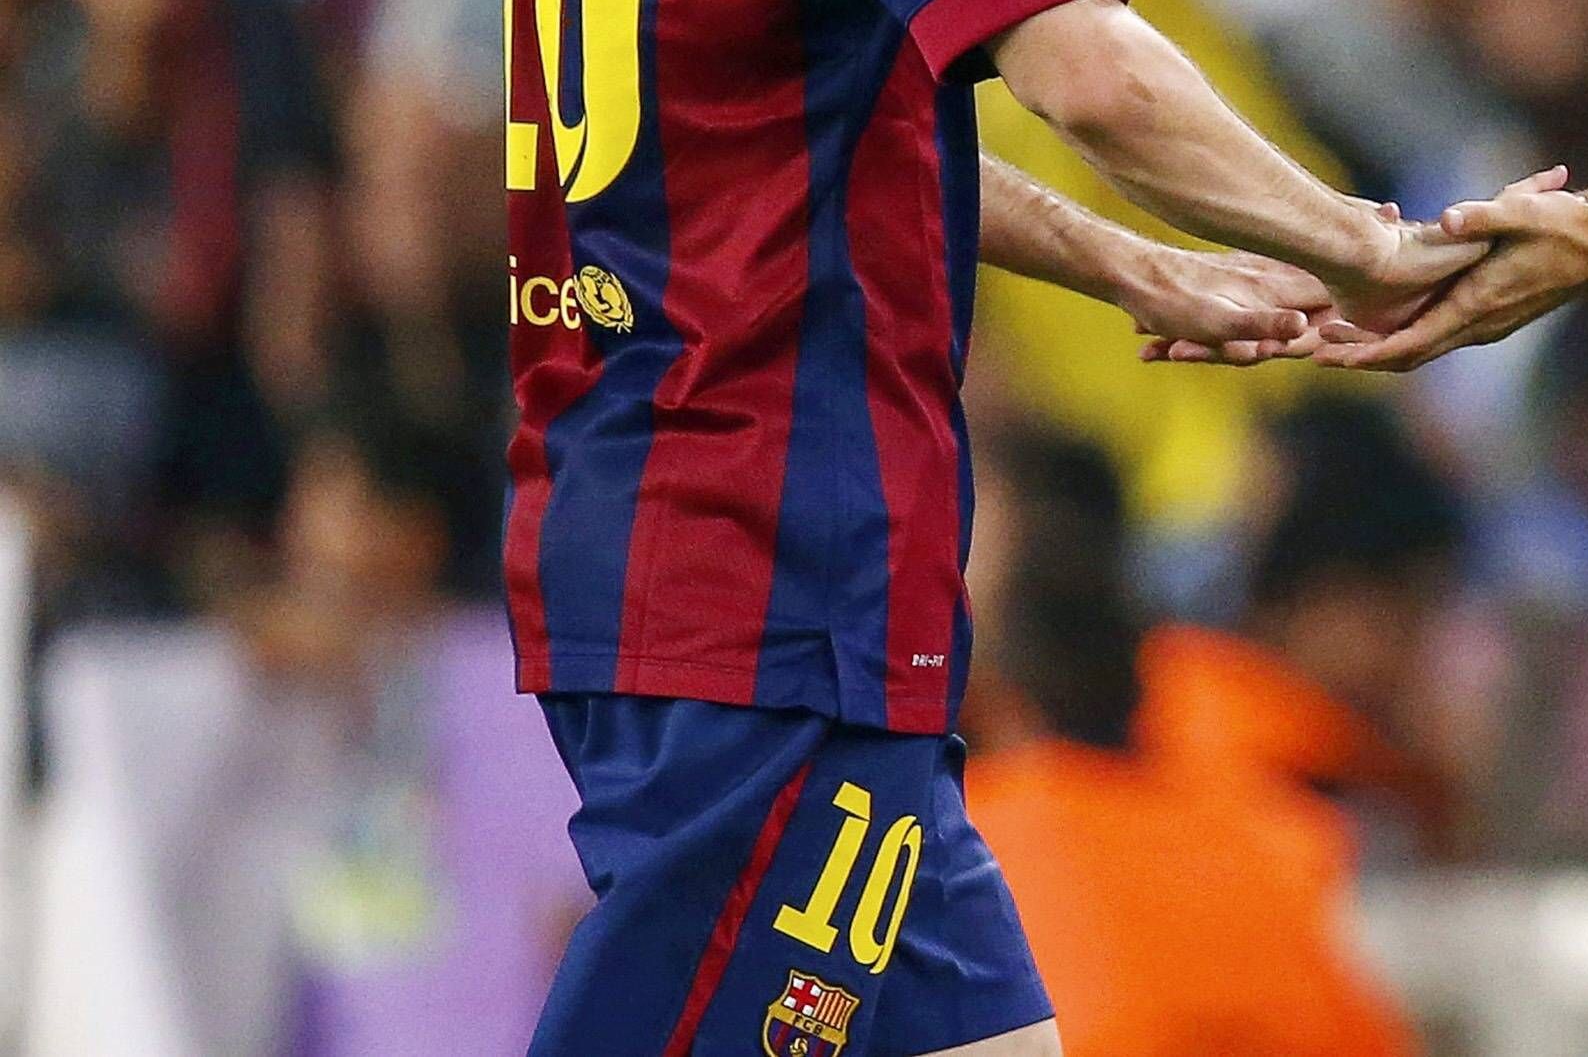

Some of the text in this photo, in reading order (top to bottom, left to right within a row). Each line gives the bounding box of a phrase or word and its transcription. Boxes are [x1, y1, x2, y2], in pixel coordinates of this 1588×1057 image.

[508, 254, 581, 330] ice
[772, 780, 922, 975] 10
[793, 1013, 824, 1036] FCB
